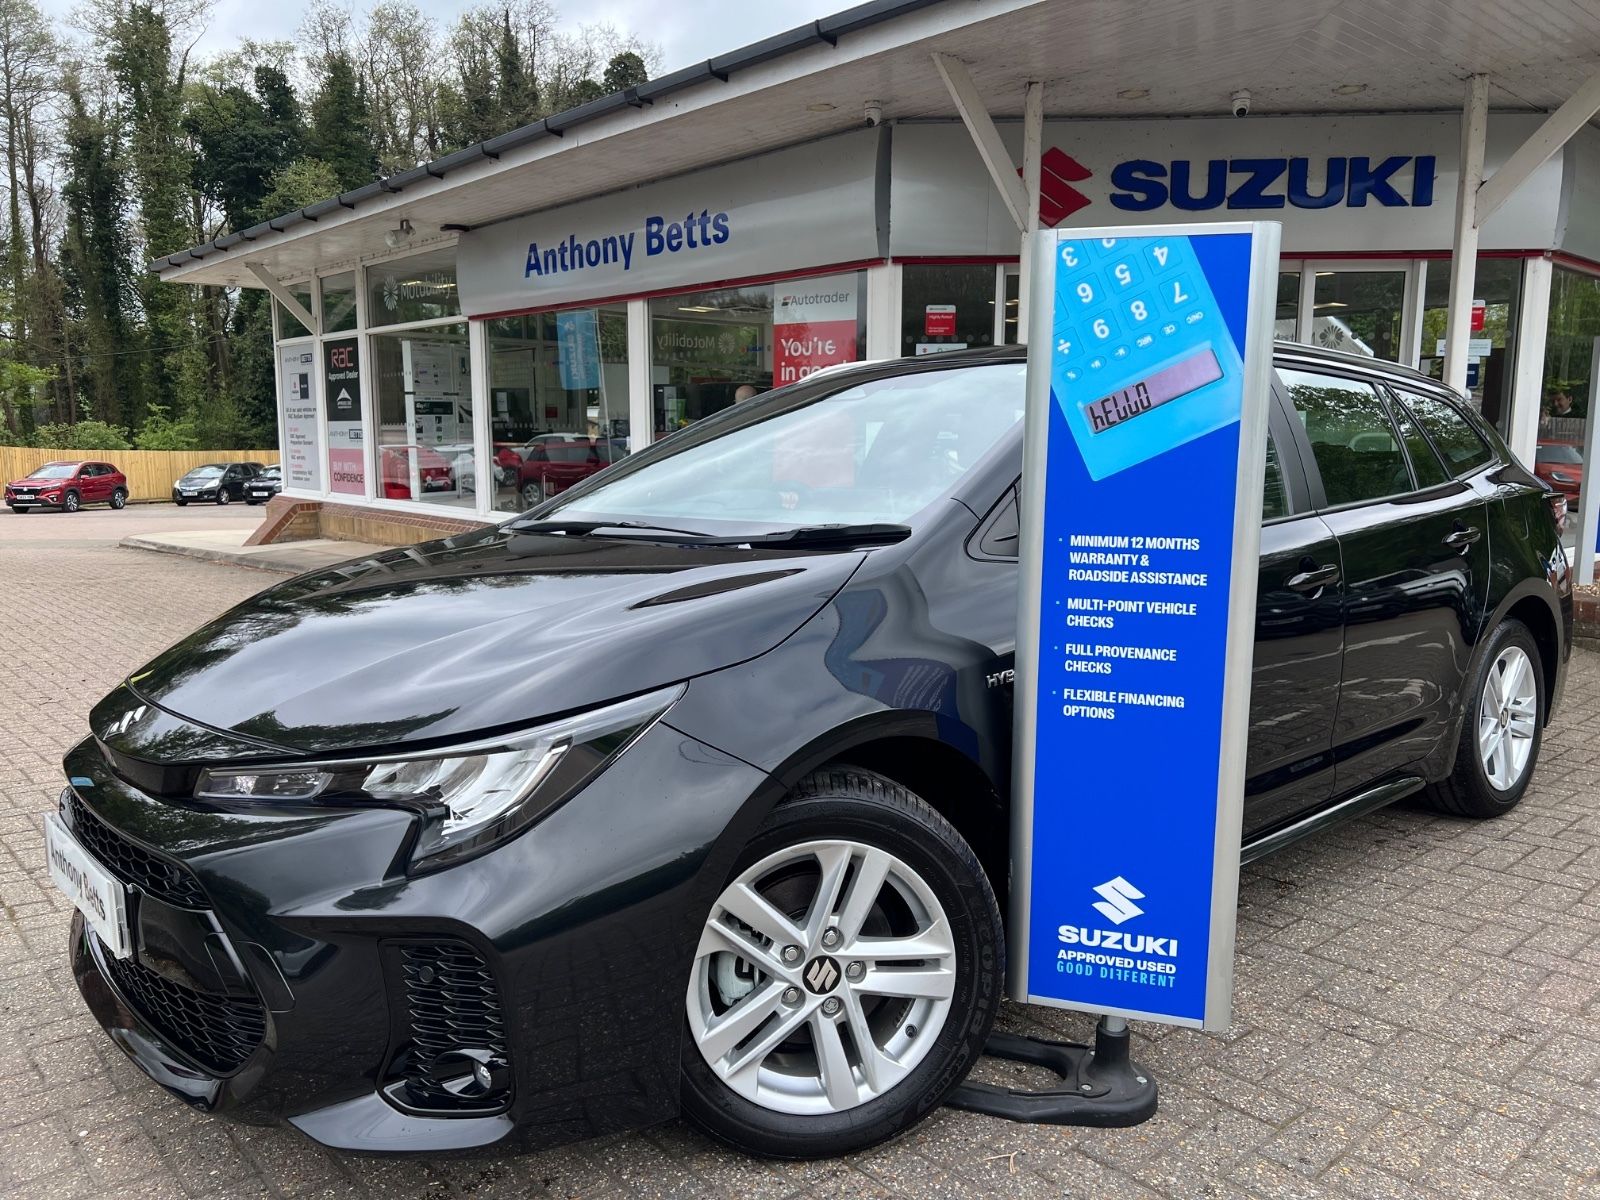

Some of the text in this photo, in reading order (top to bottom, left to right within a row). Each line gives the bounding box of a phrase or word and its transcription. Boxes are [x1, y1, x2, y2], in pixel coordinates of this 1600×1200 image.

[1109, 155, 1436, 211] SUZUKI
[525, 208, 730, 278] Anthony Betts
[1061, 247, 1078, 267] 3
[1153, 246, 1169, 266] 4
[1114, 263, 1132, 285] 5
[400, 272, 452, 301] Motability
[1076, 282, 1094, 303] 6
[1173, 281, 1189, 304] 7
[790, 291, 850, 306] Autotrader
[1130, 300, 1148, 321] 8
[1093, 318, 1110, 339] 9
[780, 337, 836, 357] You're
[780, 361, 796, 381] in
[333, 472, 364, 483] CONFIDENCE
[1070, 535, 1200, 551] MINIMUM 12 MONTHS
[1069, 552, 1150, 566] WARRANTY &
[1068, 569, 1208, 587] ROADSIDE ASSISTANCE
[1067, 598, 1197, 616] MULTI-POINT VEHICLE
[1066, 615, 1114, 629] CHECKS
[1065, 643, 1177, 662] FULL PROVENANCE
[1064, 660, 1112, 674] CHECKS
[1063, 688, 1185, 708] FLEXIBLE FINANCING
[1063, 705, 1115, 720] OPTIONS
[50, 837, 106, 921] Anthony Betts
[1057, 925, 1178, 958] SUZUKI
[1057, 949, 1177, 974] APPROVED USED
[1056, 960, 1176, 988] GOOD DIFFERENT
